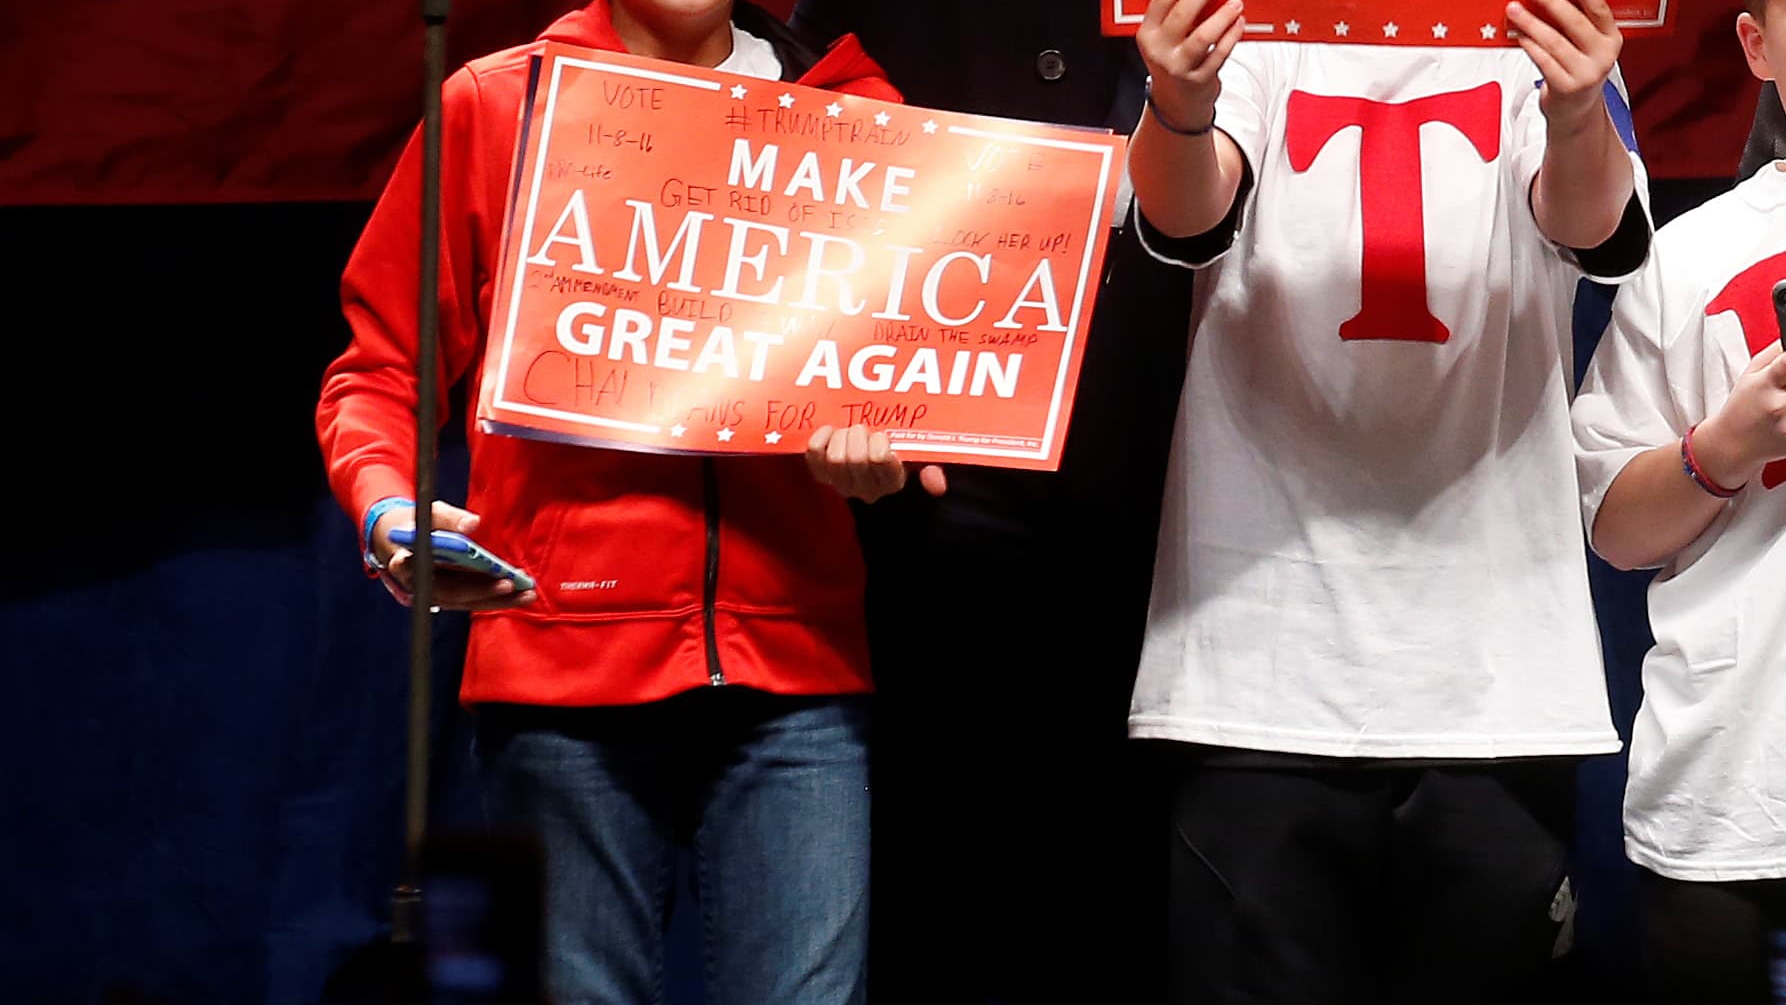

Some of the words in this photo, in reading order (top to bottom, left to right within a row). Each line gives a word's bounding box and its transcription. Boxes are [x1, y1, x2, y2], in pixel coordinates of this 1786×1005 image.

[603, 80, 664, 110] VOTE
[724, 105, 911, 147] #TRUMPTRAIN
[727, 137, 917, 214] MAKE
[660, 177, 719, 208] GET
[729, 190, 772, 216] RID
[788, 201, 816, 223] OF
[1286, 80, 1501, 344] T
[526, 188, 1068, 332] AMERICA
[997, 232, 1031, 251] HER
[1039, 233, 1072, 255] UP!
[657, 289, 733, 323] BUILD
[555, 300, 785, 382] GREAT
[795, 339, 1024, 398] AGAIN
[873, 320, 929, 343] DRAIN
[938, 328, 968, 345] THE
[978, 333, 1038, 347] SWAMP
[765, 399, 817, 431] FOR
[841, 400, 928, 429] TRUMP
